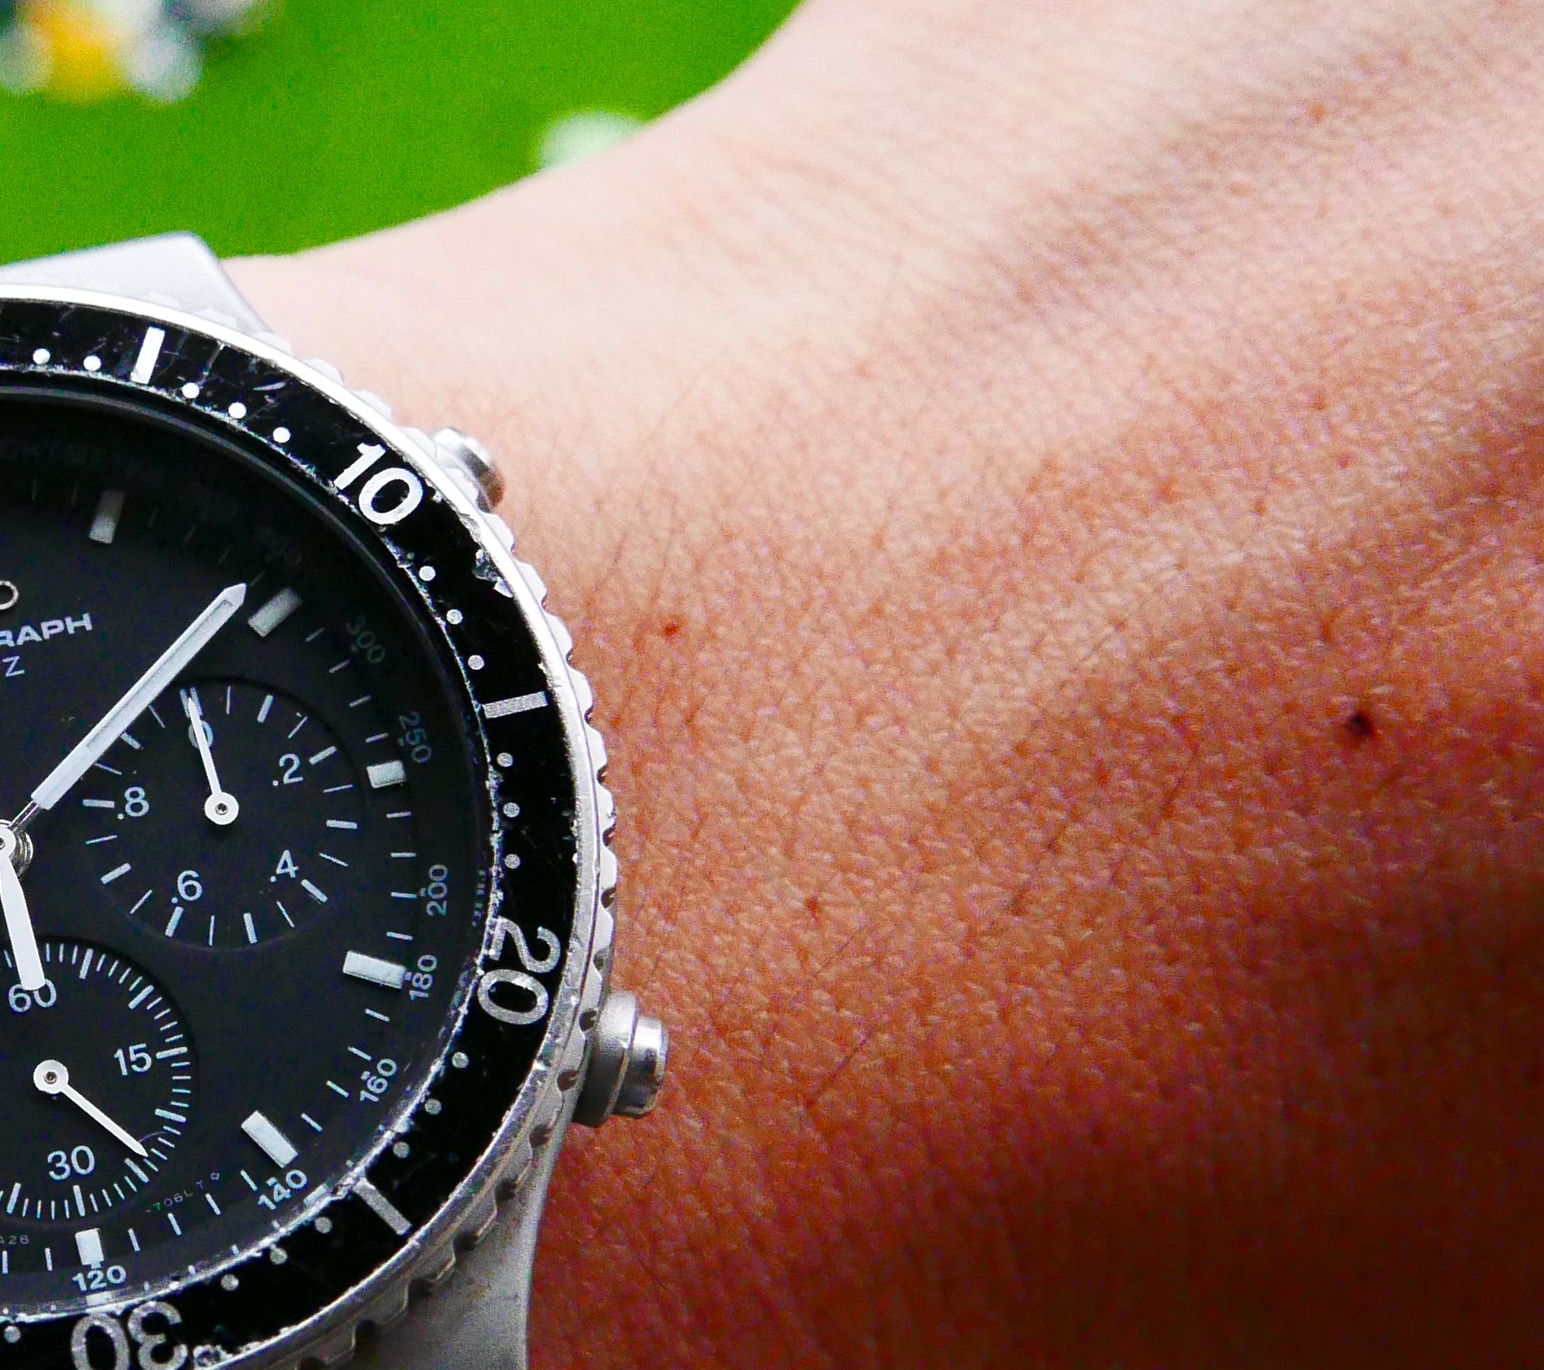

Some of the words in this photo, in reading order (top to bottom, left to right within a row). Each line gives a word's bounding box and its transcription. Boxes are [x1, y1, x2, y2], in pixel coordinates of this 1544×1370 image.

[333, 442, 424, 525] 10
[399, 711, 432, 763] 250
[426, 864, 448, 916] 200
[409, 954, 438, 1001] 180
[477, 915, 561, 1025] 20
[8, 979, 57, 1013] 60
[113, 1043, 152, 1076] 15
[360, 1058, 398, 1102] 160
[47, 1145, 95, 1180] 30
[258, 1169, 307, 1210] 140
[72, 1265, 126, 1291] 120
